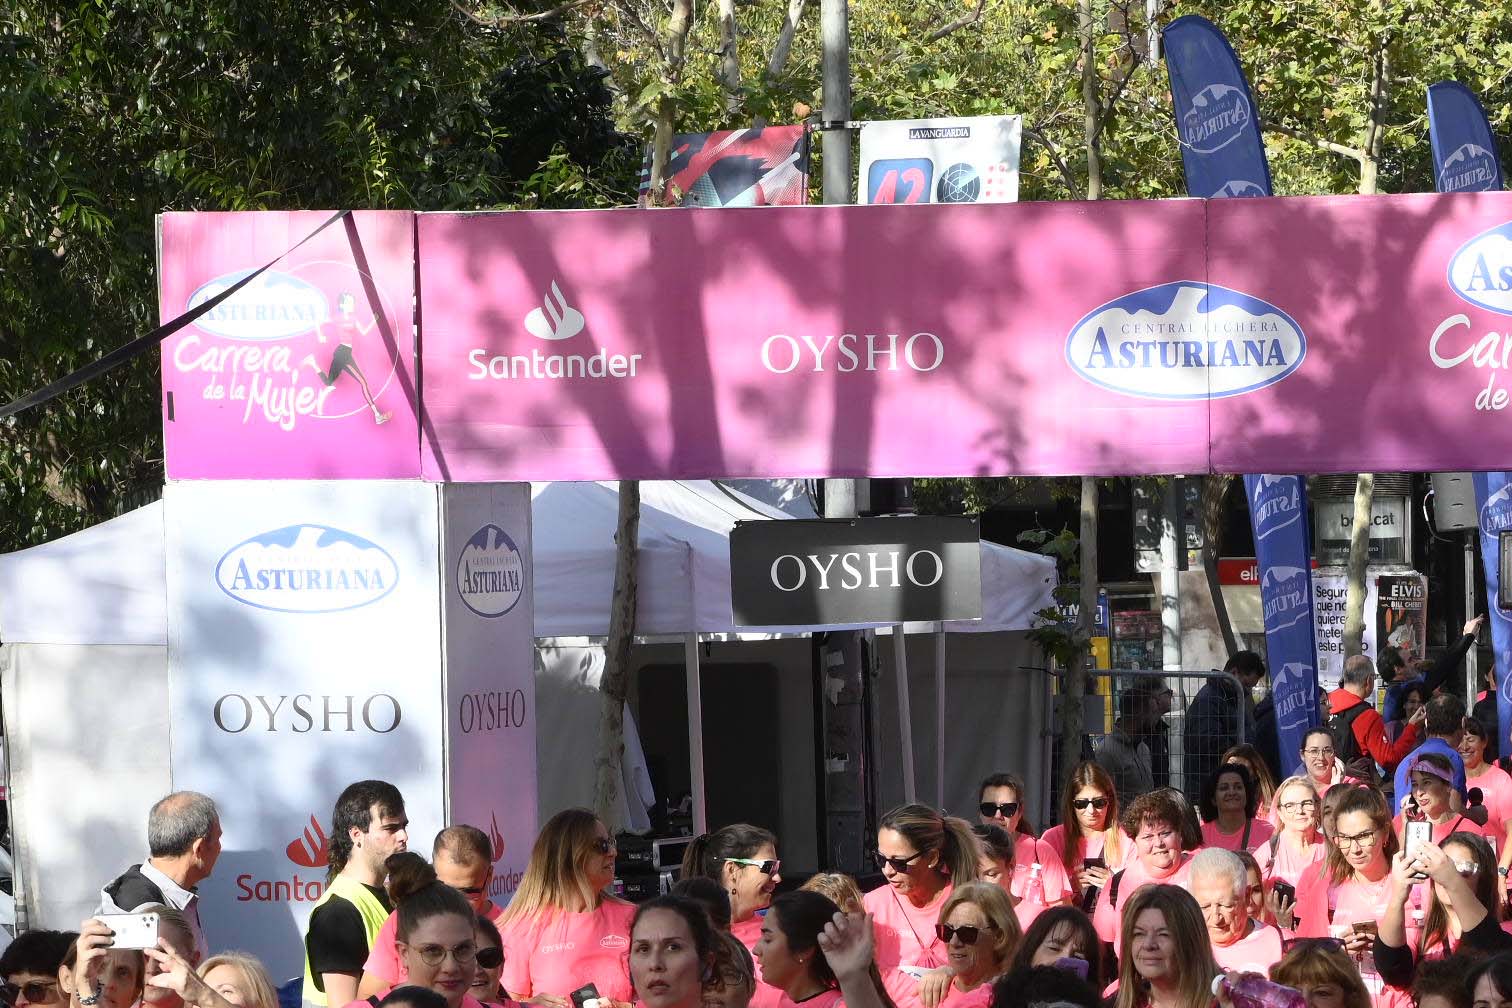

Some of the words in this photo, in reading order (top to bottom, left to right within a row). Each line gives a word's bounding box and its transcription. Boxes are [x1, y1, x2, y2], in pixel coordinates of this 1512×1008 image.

[174, 335, 291, 373] Carrera
[468, 349, 641, 378] Santander
[760, 331, 944, 373] OYSHO
[1084, 325, 1287, 369] ASTURIANA
[243, 370, 336, 430] Mujer
[1475, 373, 1510, 411] de
[230, 557, 385, 590] ASTURIANA
[463, 559, 520, 594] ASTURIANA
[771, 551, 943, 592] OYSHO
[1391, 584, 1422, 597] ELVIS
[1316, 602, 1332, 611] que
[1318, 643, 1336, 652] este
[213, 693, 402, 733] OYSHO
[460, 689, 526, 734] OYSHO
[236, 874, 328, 902] Santa
